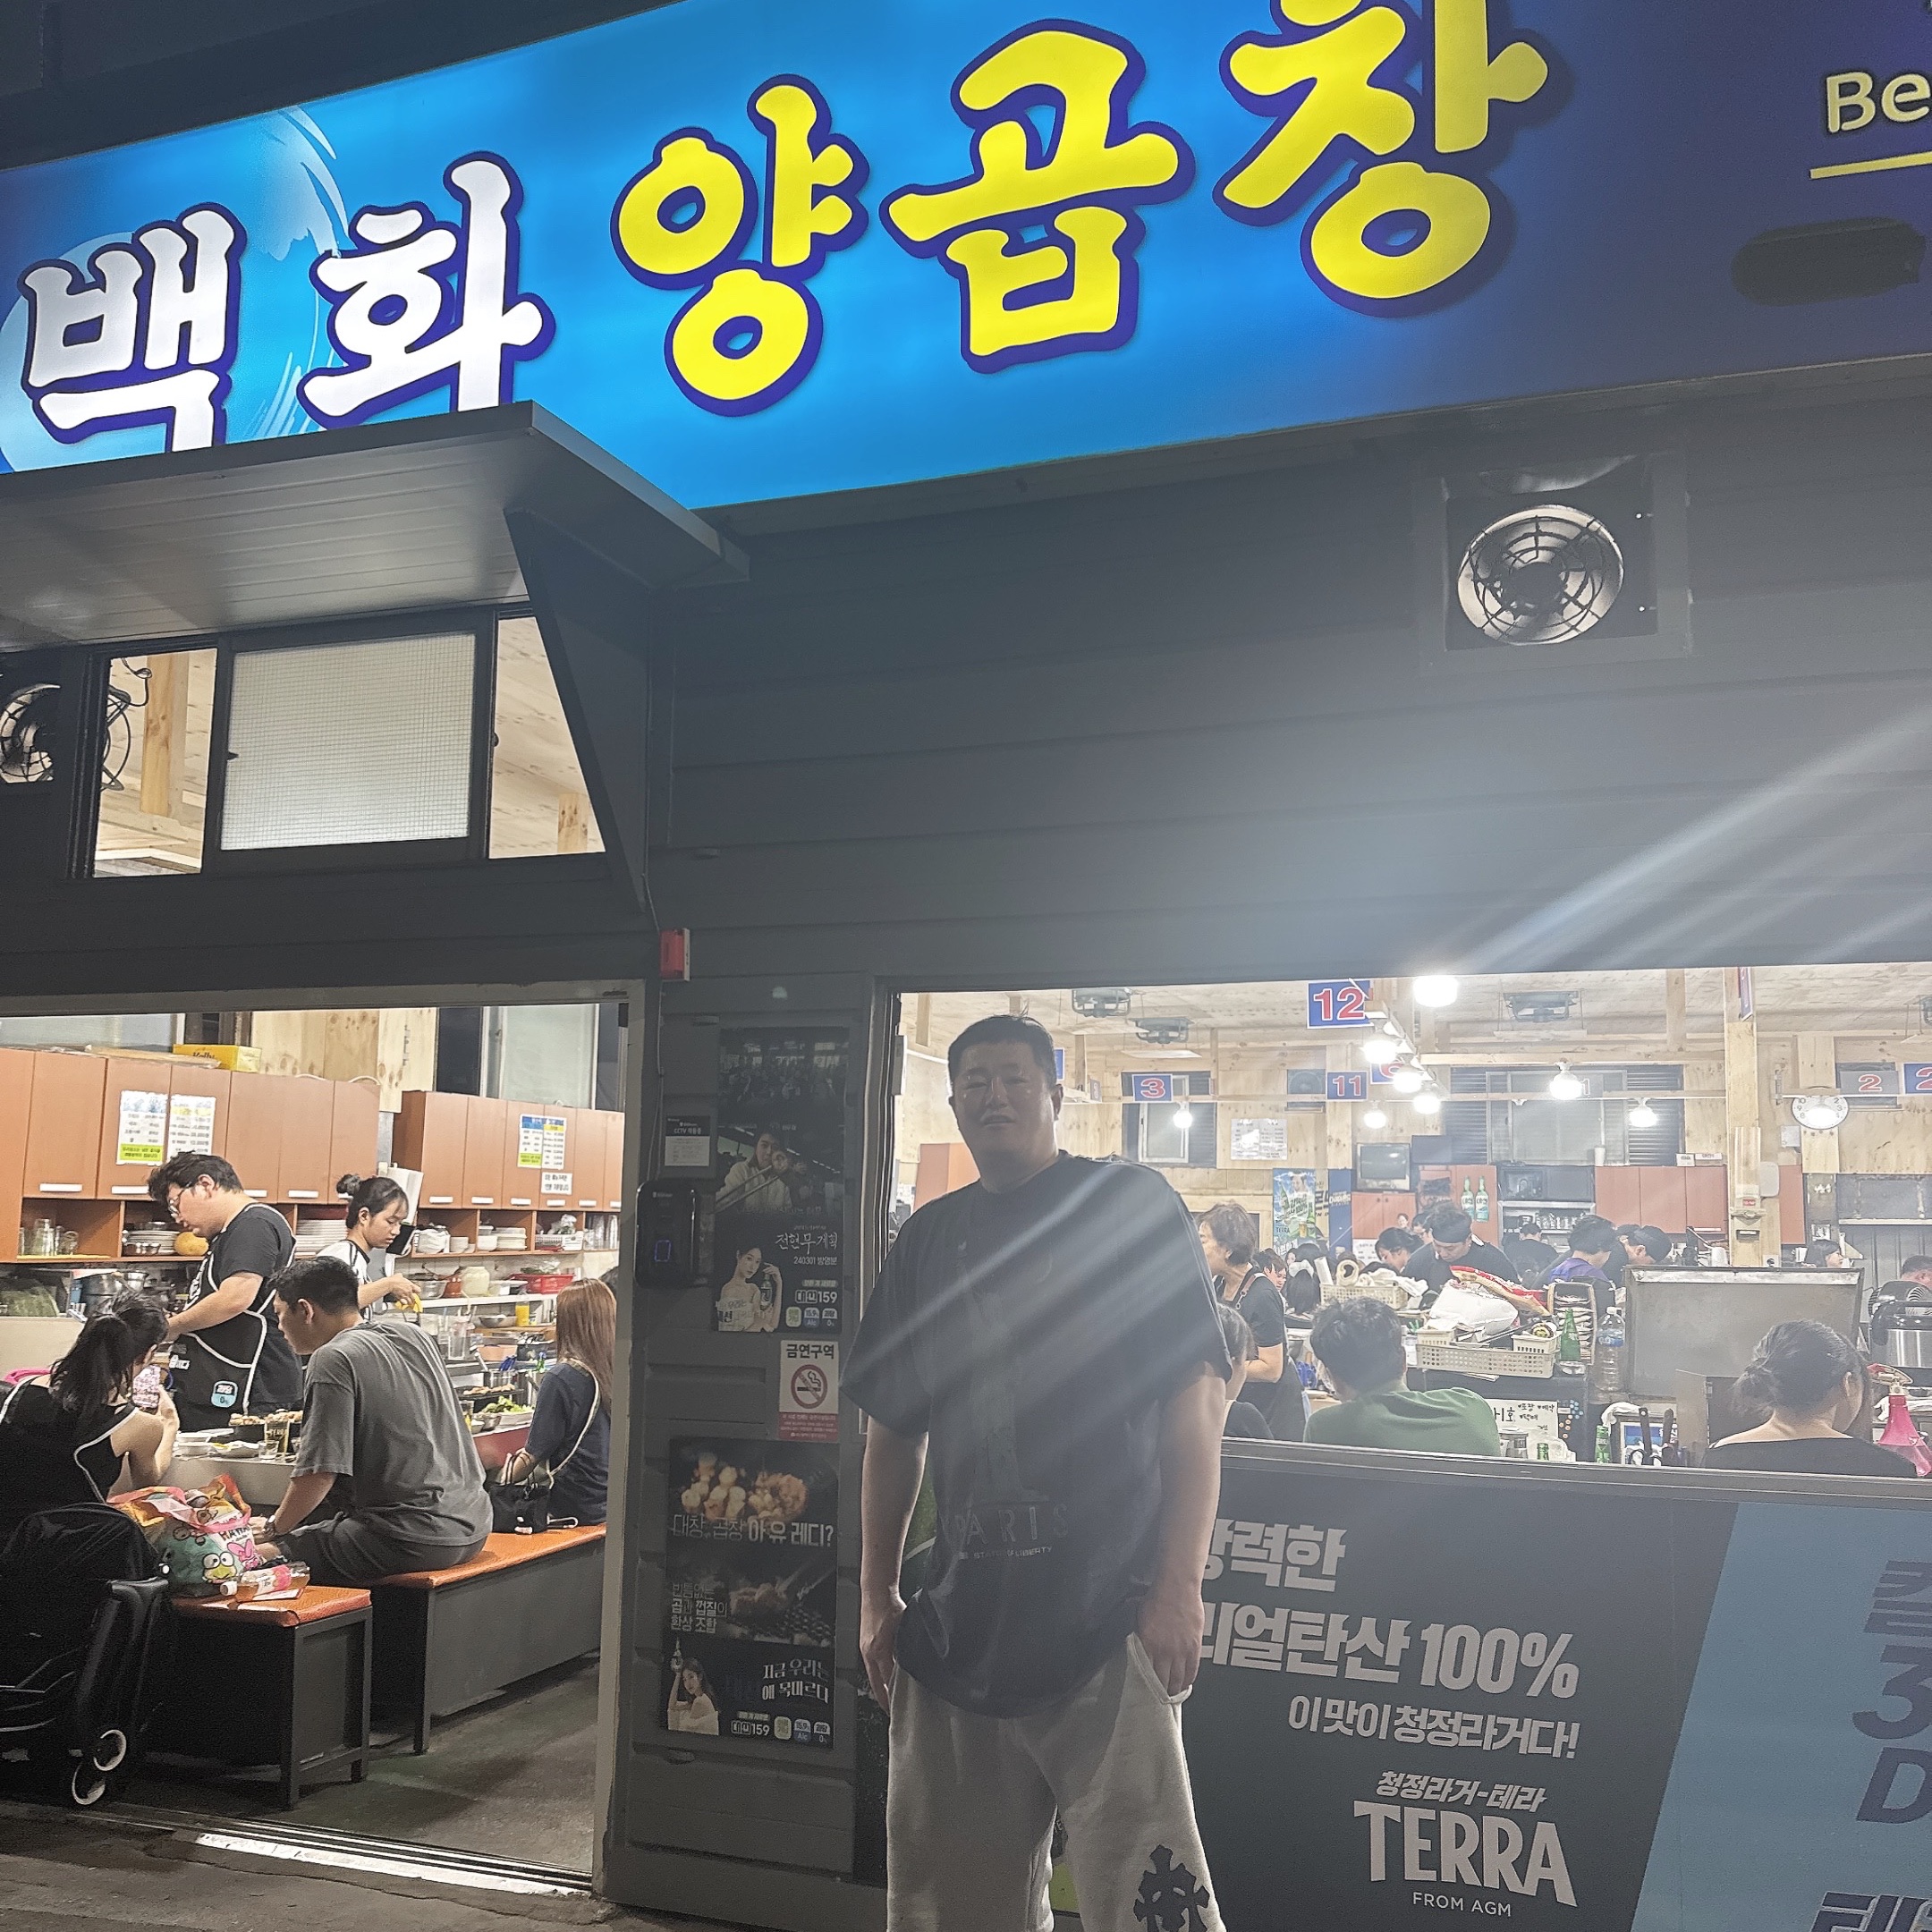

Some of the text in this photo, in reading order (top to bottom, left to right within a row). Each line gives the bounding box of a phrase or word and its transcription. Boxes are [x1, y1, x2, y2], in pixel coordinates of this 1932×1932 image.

[615, 0, 1549, 402] 양곱창
[1313, 986, 1365, 1021] 12
[1140, 1078, 1165, 1098] 3
[1333, 1075, 1361, 1097] 11
[1858, 1073, 1883, 1092] 2
[775, 1233, 838, 1254] 전현무계획
[794, 1256, 816, 1265] 240301
[786, 1344, 835, 1360] 금연구역
[791, 1521, 834, 1547] 레디?
[1015, 1546, 1053, 1557] LIBERTY
[1419, 1623, 1580, 1699] 100%
[1353, 1800, 1578, 1908] TERRA
[1412, 1891, 1512, 1917] FROM AGM
